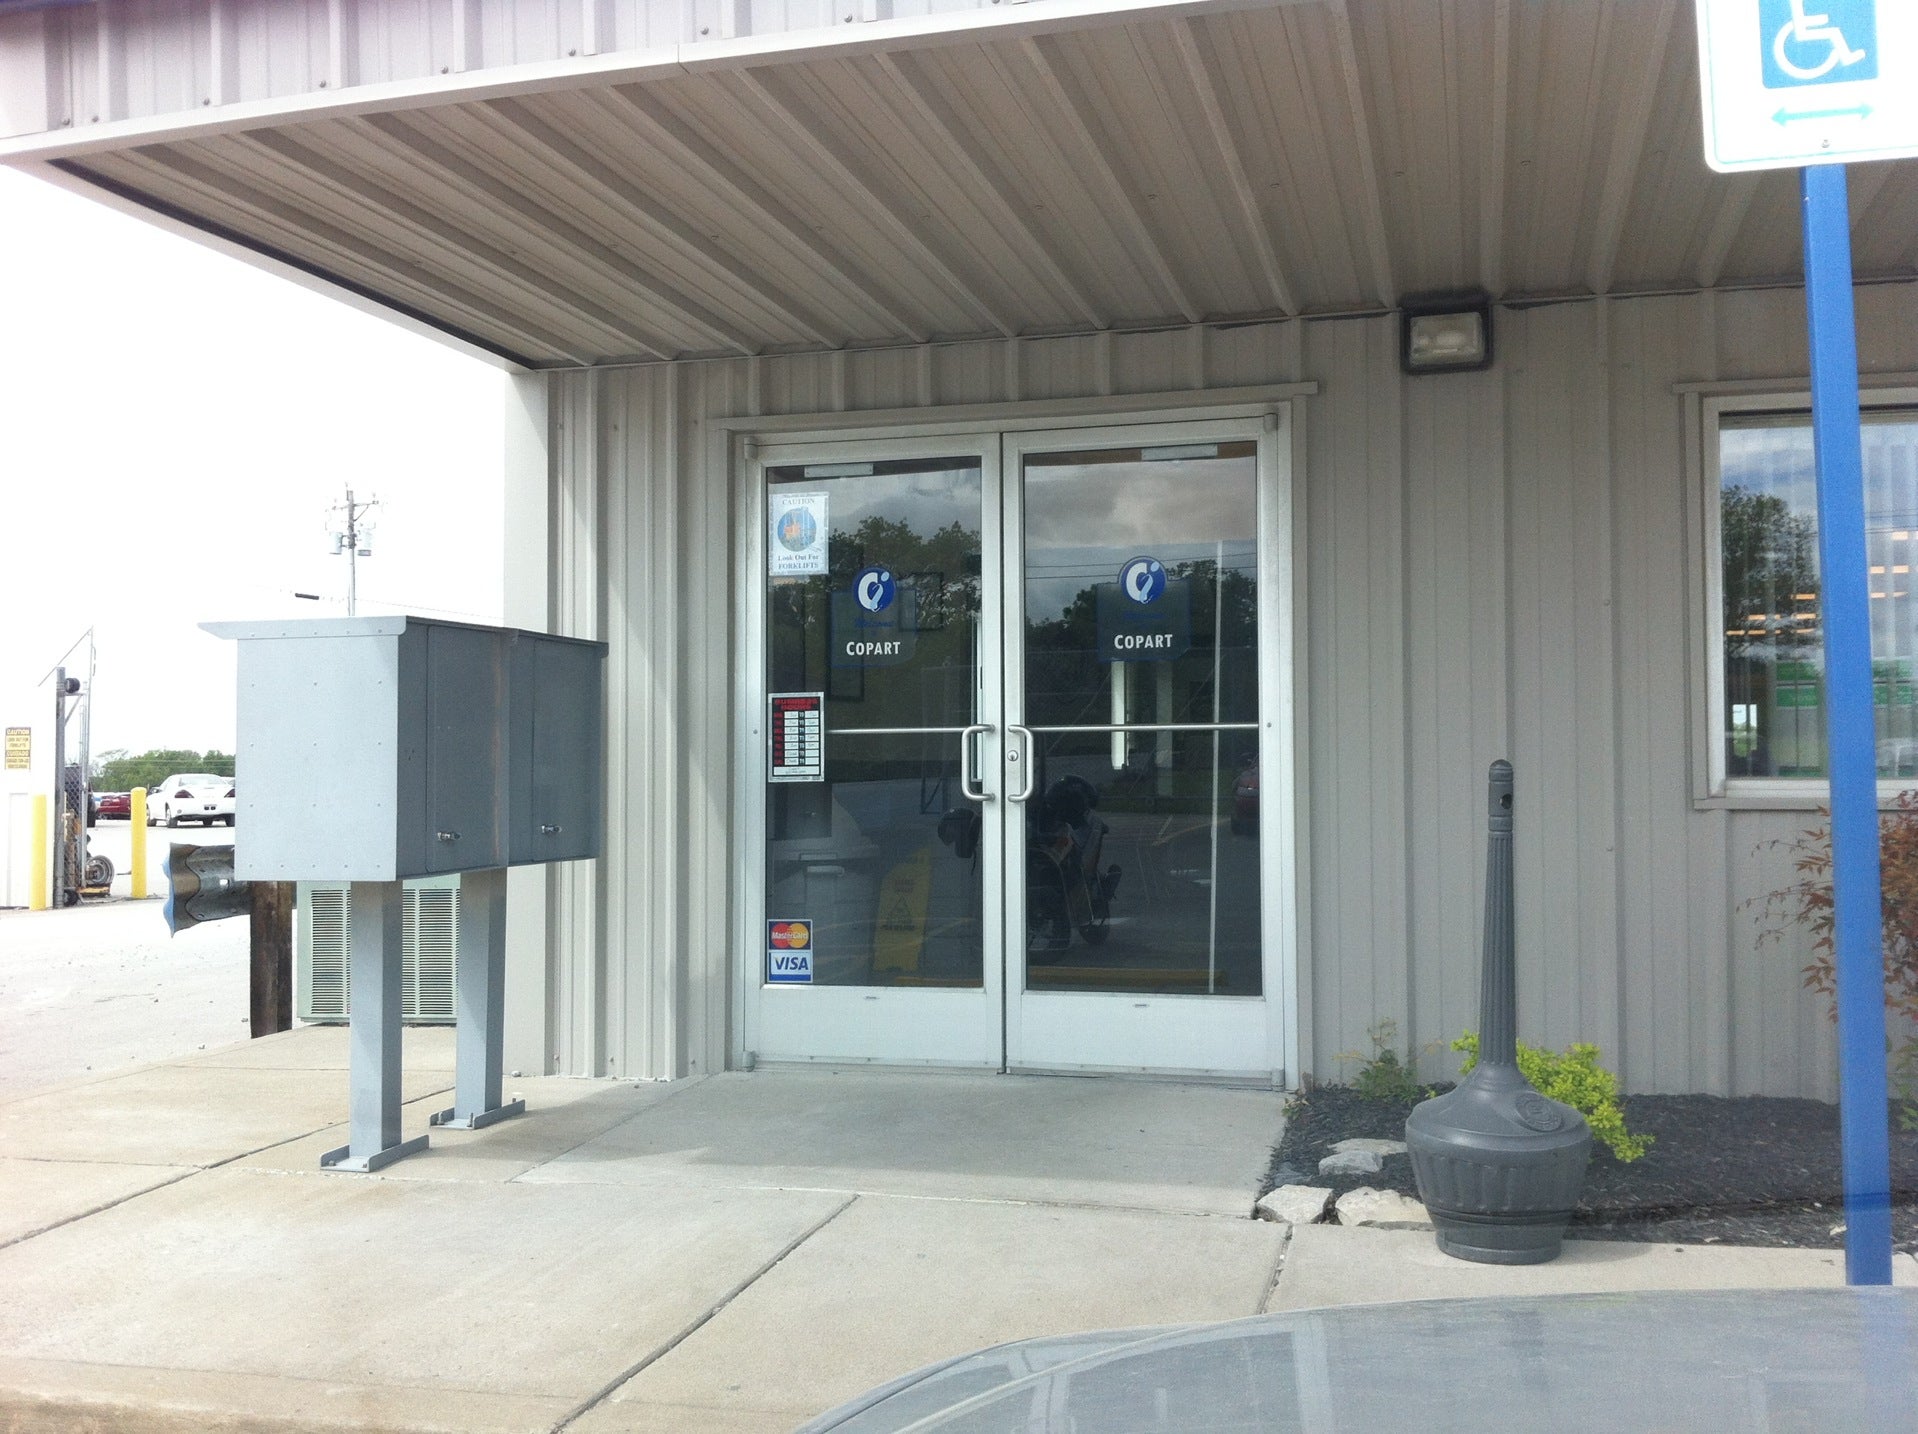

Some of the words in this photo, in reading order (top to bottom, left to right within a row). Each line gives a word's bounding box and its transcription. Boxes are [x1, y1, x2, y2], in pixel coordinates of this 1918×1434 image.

[782, 497, 815, 505] CAUTION
[778, 562, 819, 570] FORKLIFTS
[846, 641, 901, 656] COPART
[1114, 634, 1173, 649] COPART
[775, 956, 809, 970] VISA
